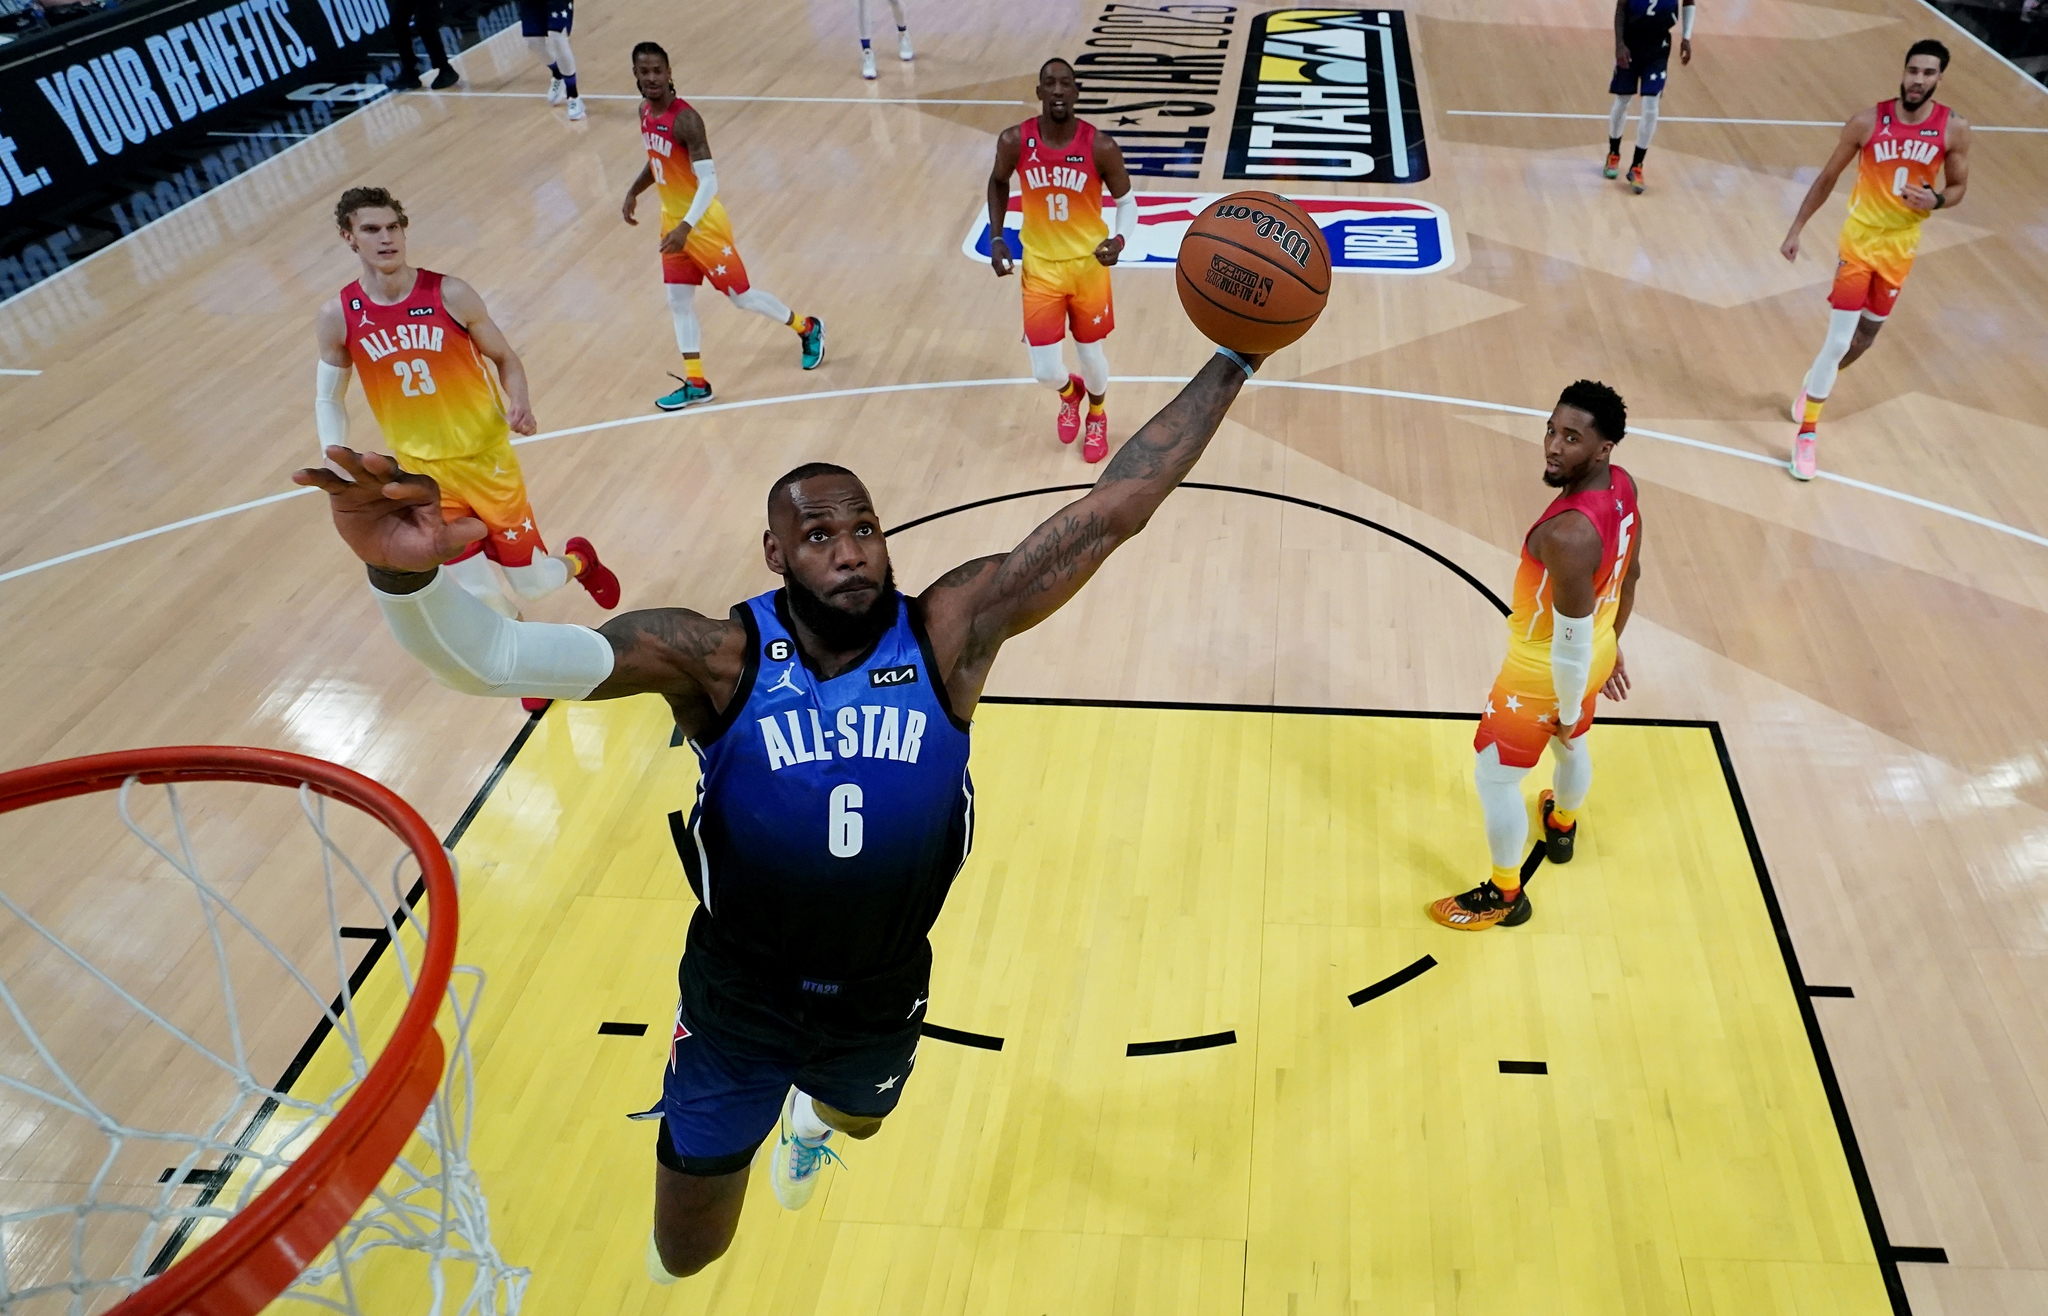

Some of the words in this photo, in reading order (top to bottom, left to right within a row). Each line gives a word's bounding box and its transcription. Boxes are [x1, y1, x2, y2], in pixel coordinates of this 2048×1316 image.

[35, 45, 174, 166] YOUR
[144, 0, 317, 123] BENEFITS.
[1245, 84, 1375, 177] UTAH
[1873, 139, 1939, 166] ALL-STAR
[1025, 165, 1088, 193] ALL-STAR
[1892, 166, 1909, 197] 0
[1045, 193, 1070, 222] 13
[1215, 204, 1312, 269] Wilson
[1344, 225, 1419, 262] NBA
[1233, 267, 1257, 288] UTAH
[352, 299, 361, 310] 6
[359, 324, 444, 362] ALL-STAR
[393, 358, 437, 397] 23
[771, 641, 788, 660] 6
[757, 705, 927, 772] ALL-STAR
[828, 783, 864, 858] 6
